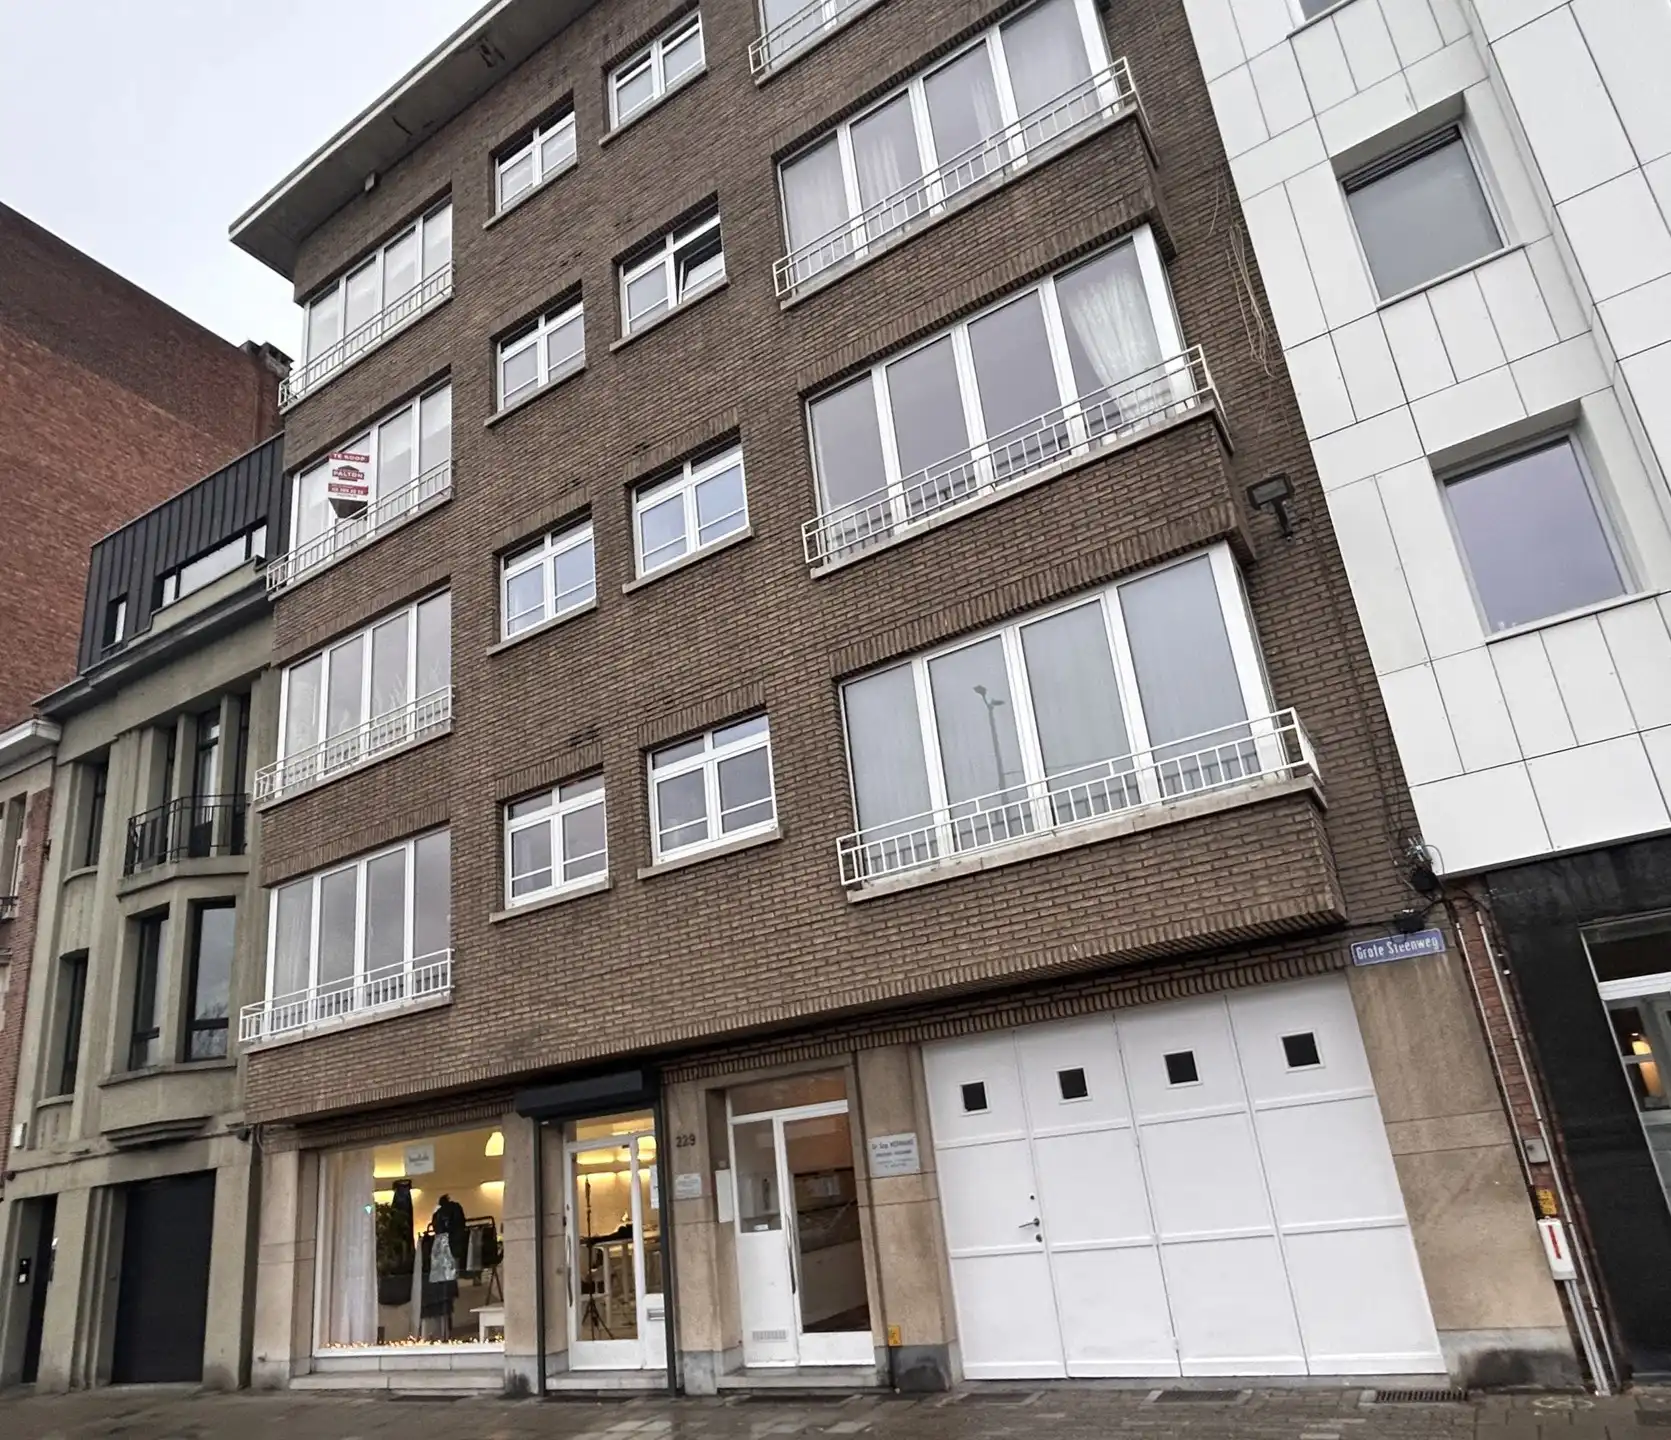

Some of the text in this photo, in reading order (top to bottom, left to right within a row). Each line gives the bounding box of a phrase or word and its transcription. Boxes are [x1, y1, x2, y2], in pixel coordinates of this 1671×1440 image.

[1355, 936, 1440, 960] Grote Steenweg
[676, 1133, 696, 1148] 229
